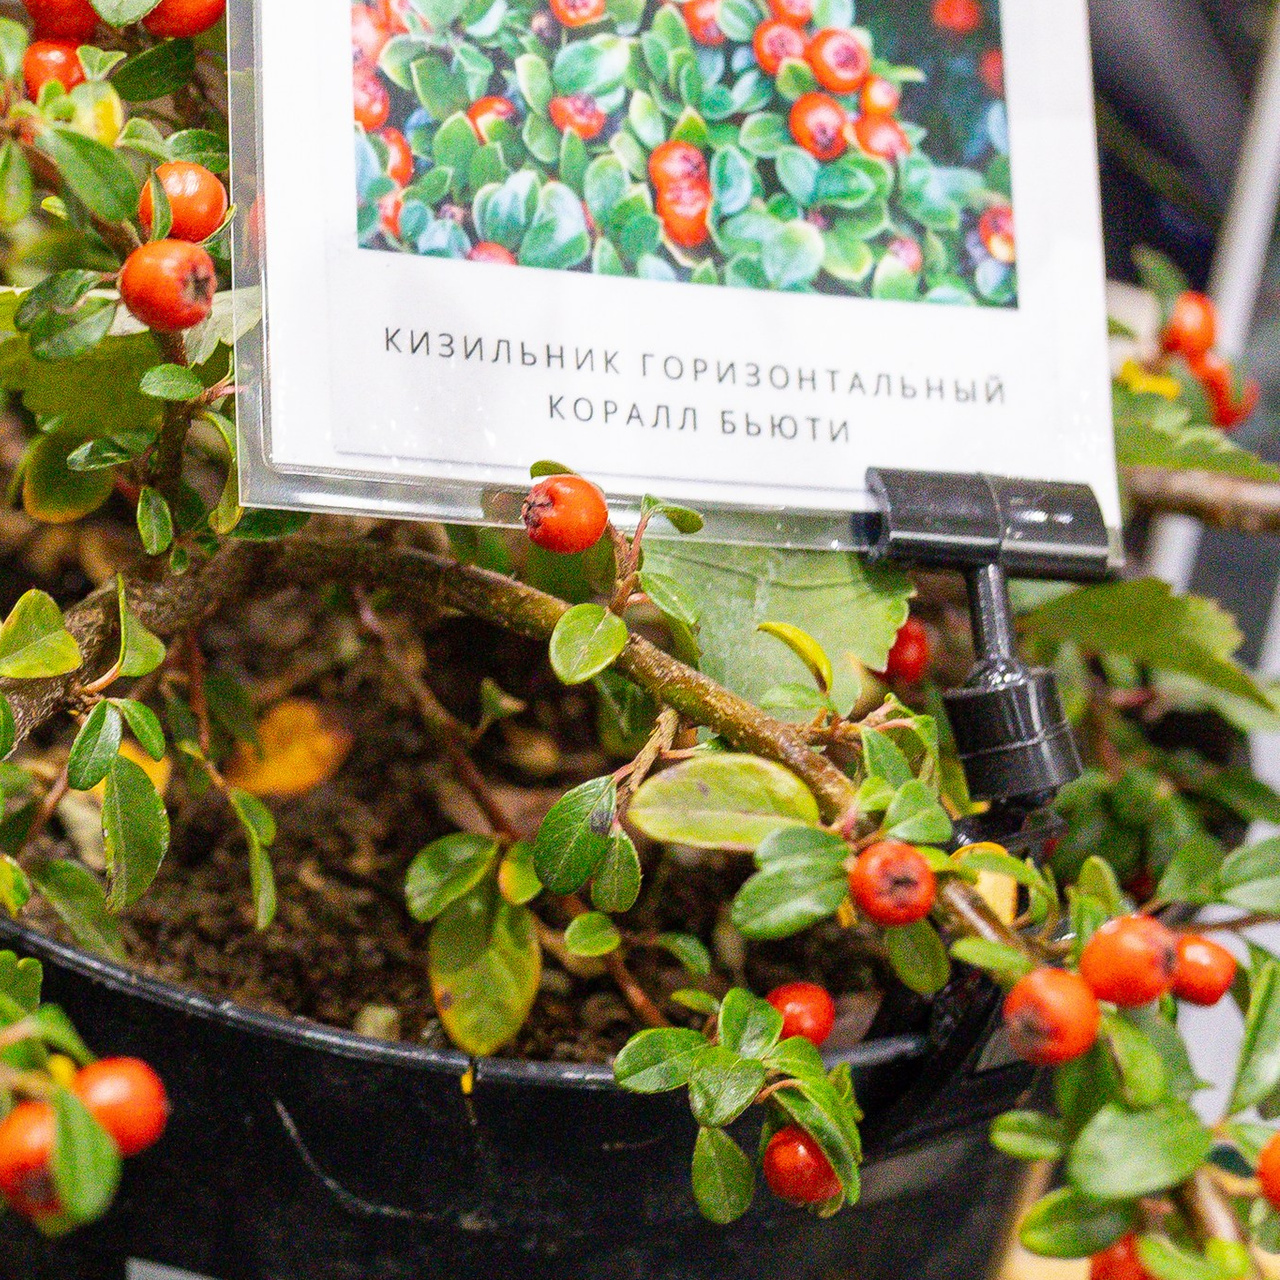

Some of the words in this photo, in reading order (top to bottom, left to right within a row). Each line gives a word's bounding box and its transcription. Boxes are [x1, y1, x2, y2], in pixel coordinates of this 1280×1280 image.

[384, 326, 620, 375] КИЗИЛЬНИК
[642, 353, 1006, 405] ГОРИЗОНТАЛЬНЫЙ
[548, 394, 698, 432] КОРАЛЛ
[720, 409, 850, 443] БЬЮТИ
